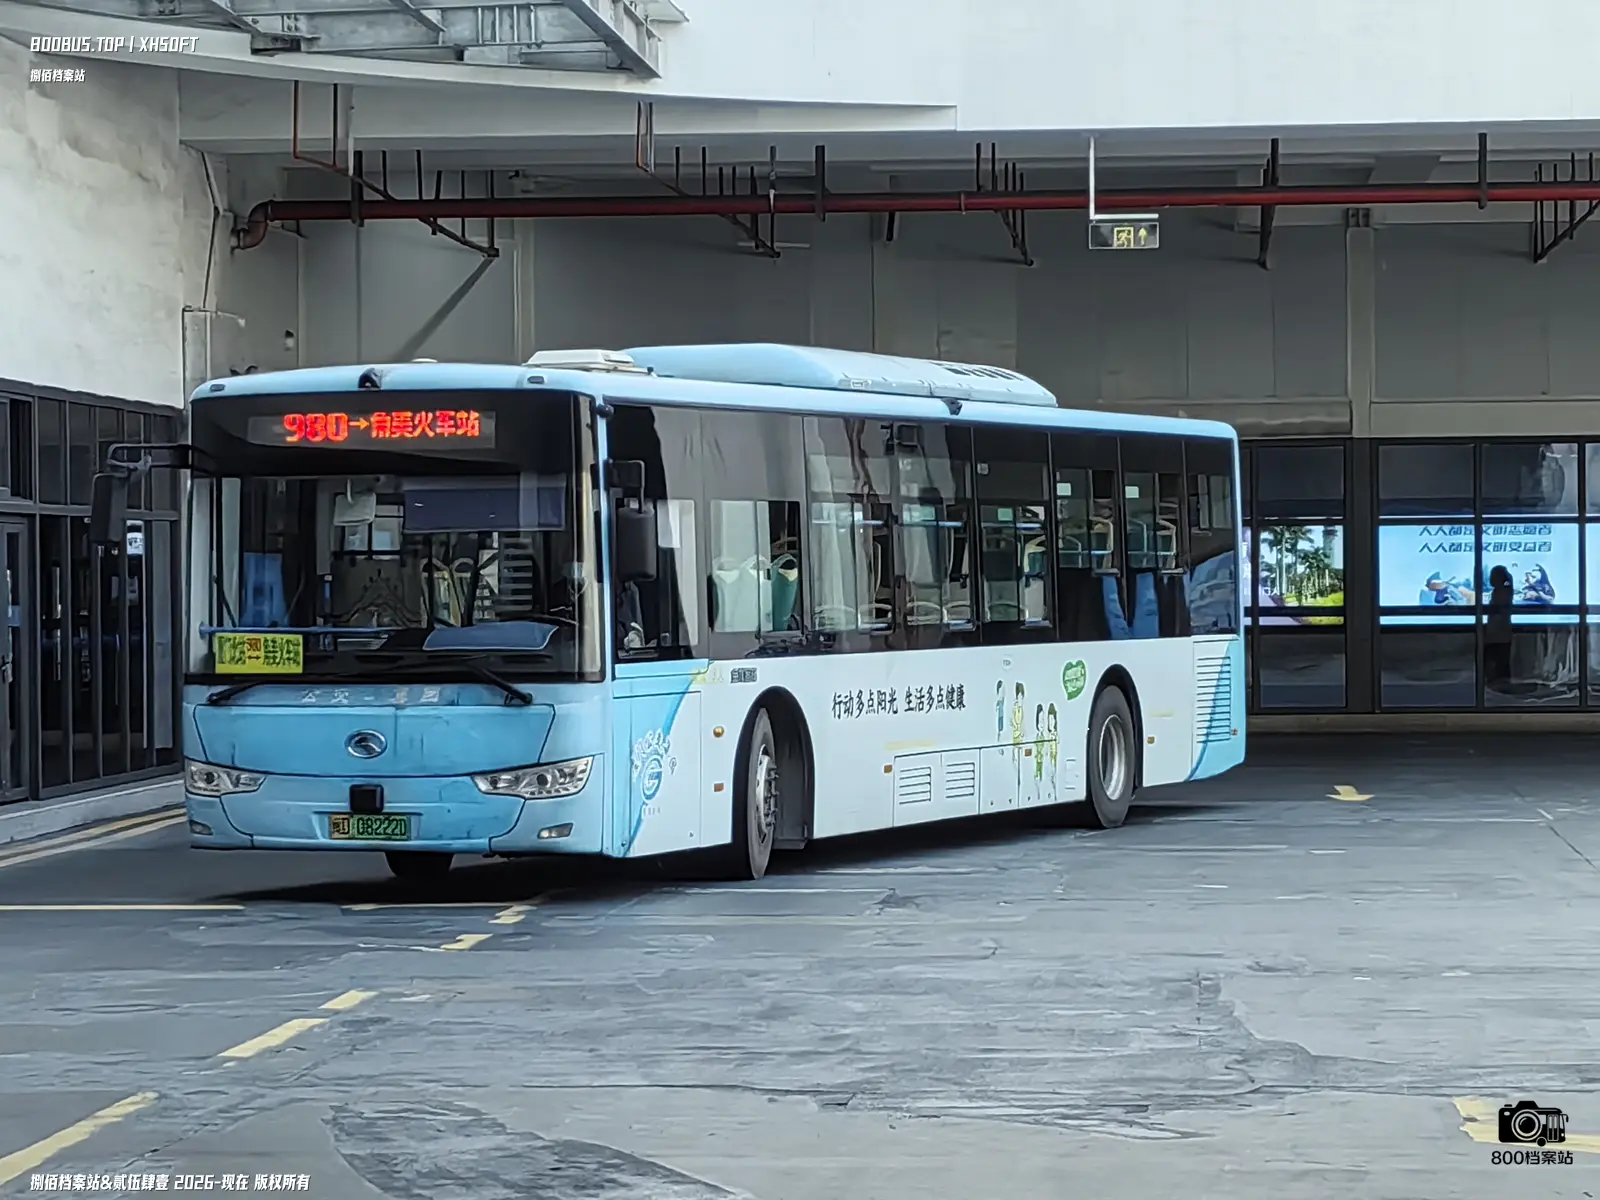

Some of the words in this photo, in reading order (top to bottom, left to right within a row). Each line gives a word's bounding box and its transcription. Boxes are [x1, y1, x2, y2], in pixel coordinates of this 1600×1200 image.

[283, 412, 349, 443] 980
[370, 410, 481, 438] 角美火车站
[832, 686, 899, 720] 行动多点阳光
[904, 683, 966, 714] 生活多点健康
